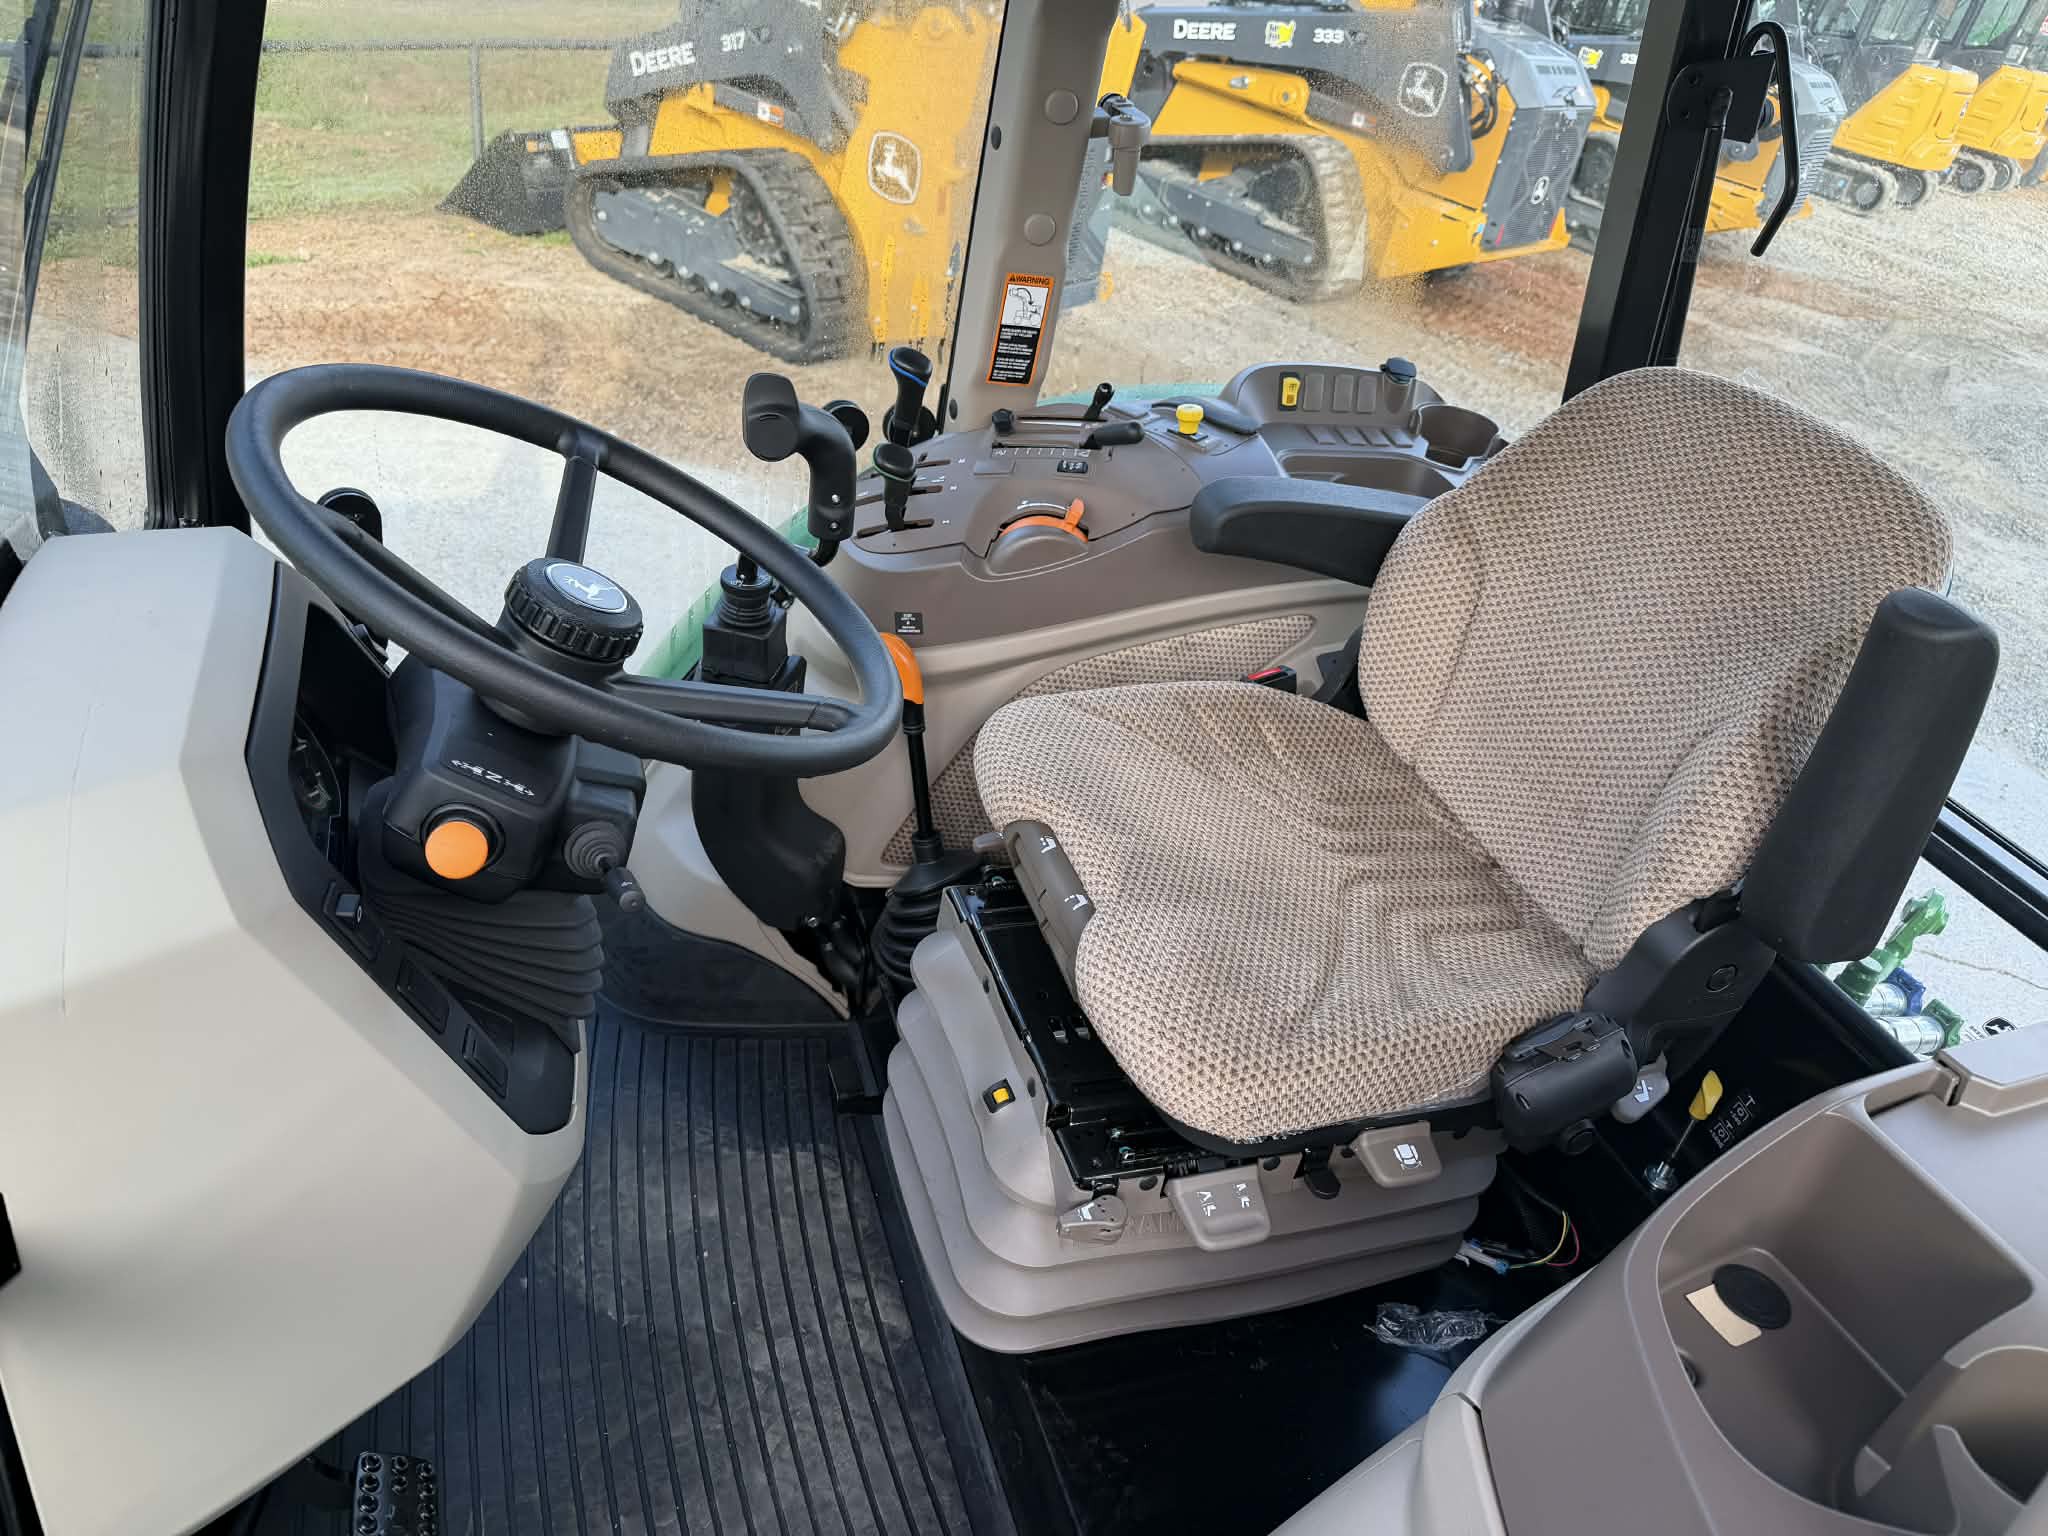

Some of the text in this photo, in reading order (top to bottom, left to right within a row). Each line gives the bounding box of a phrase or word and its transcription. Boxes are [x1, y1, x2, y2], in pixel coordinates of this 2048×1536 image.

[720, 29, 746, 53] 317
[1173, 19, 1237, 41] DEERE
[1312, 28, 1345, 43] 333
[629, 41, 697, 77] DEERE
[1015, 275, 1050, 287] WARNING
